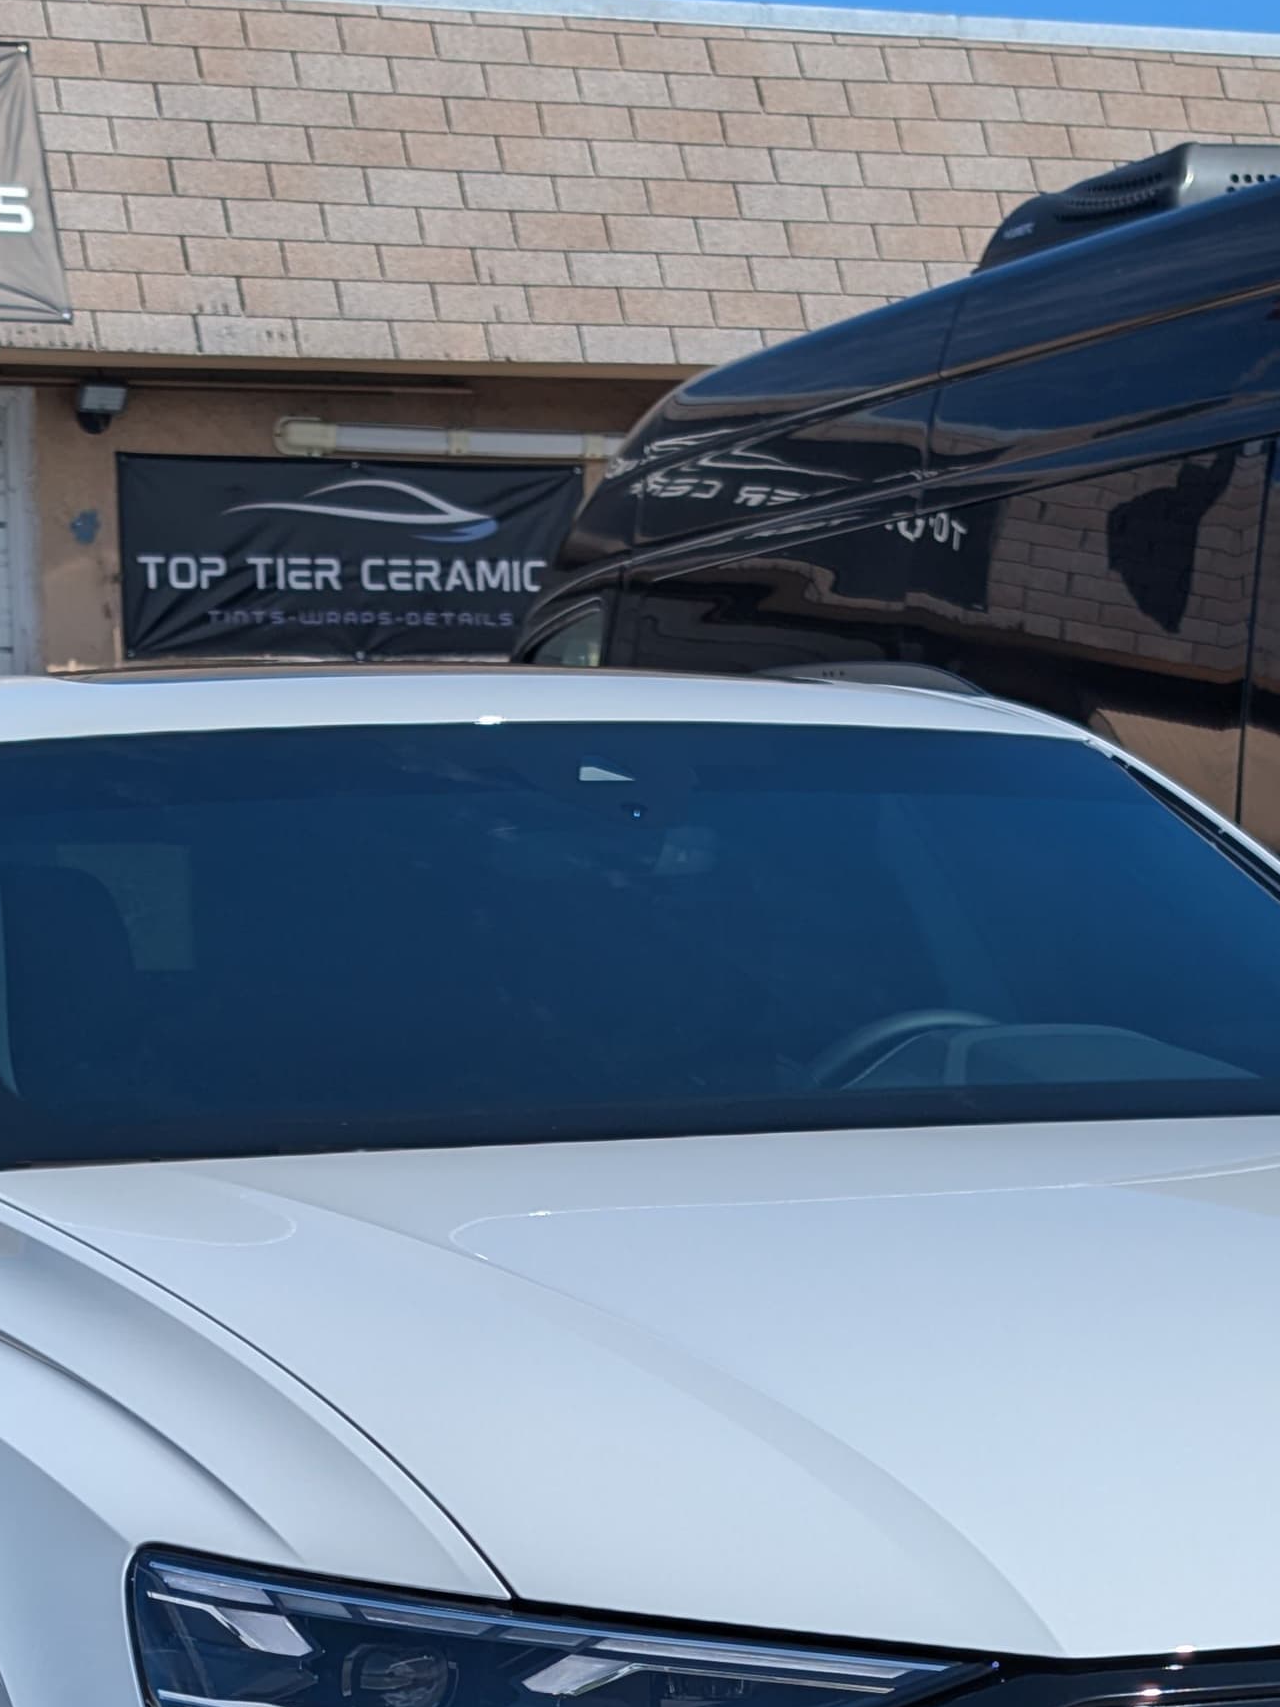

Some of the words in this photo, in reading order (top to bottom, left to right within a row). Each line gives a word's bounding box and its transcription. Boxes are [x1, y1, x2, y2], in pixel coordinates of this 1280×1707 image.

[136, 555, 227, 590] TOP
[246, 556, 342, 591] TIER
[361, 557, 548, 593] CERAMIC
